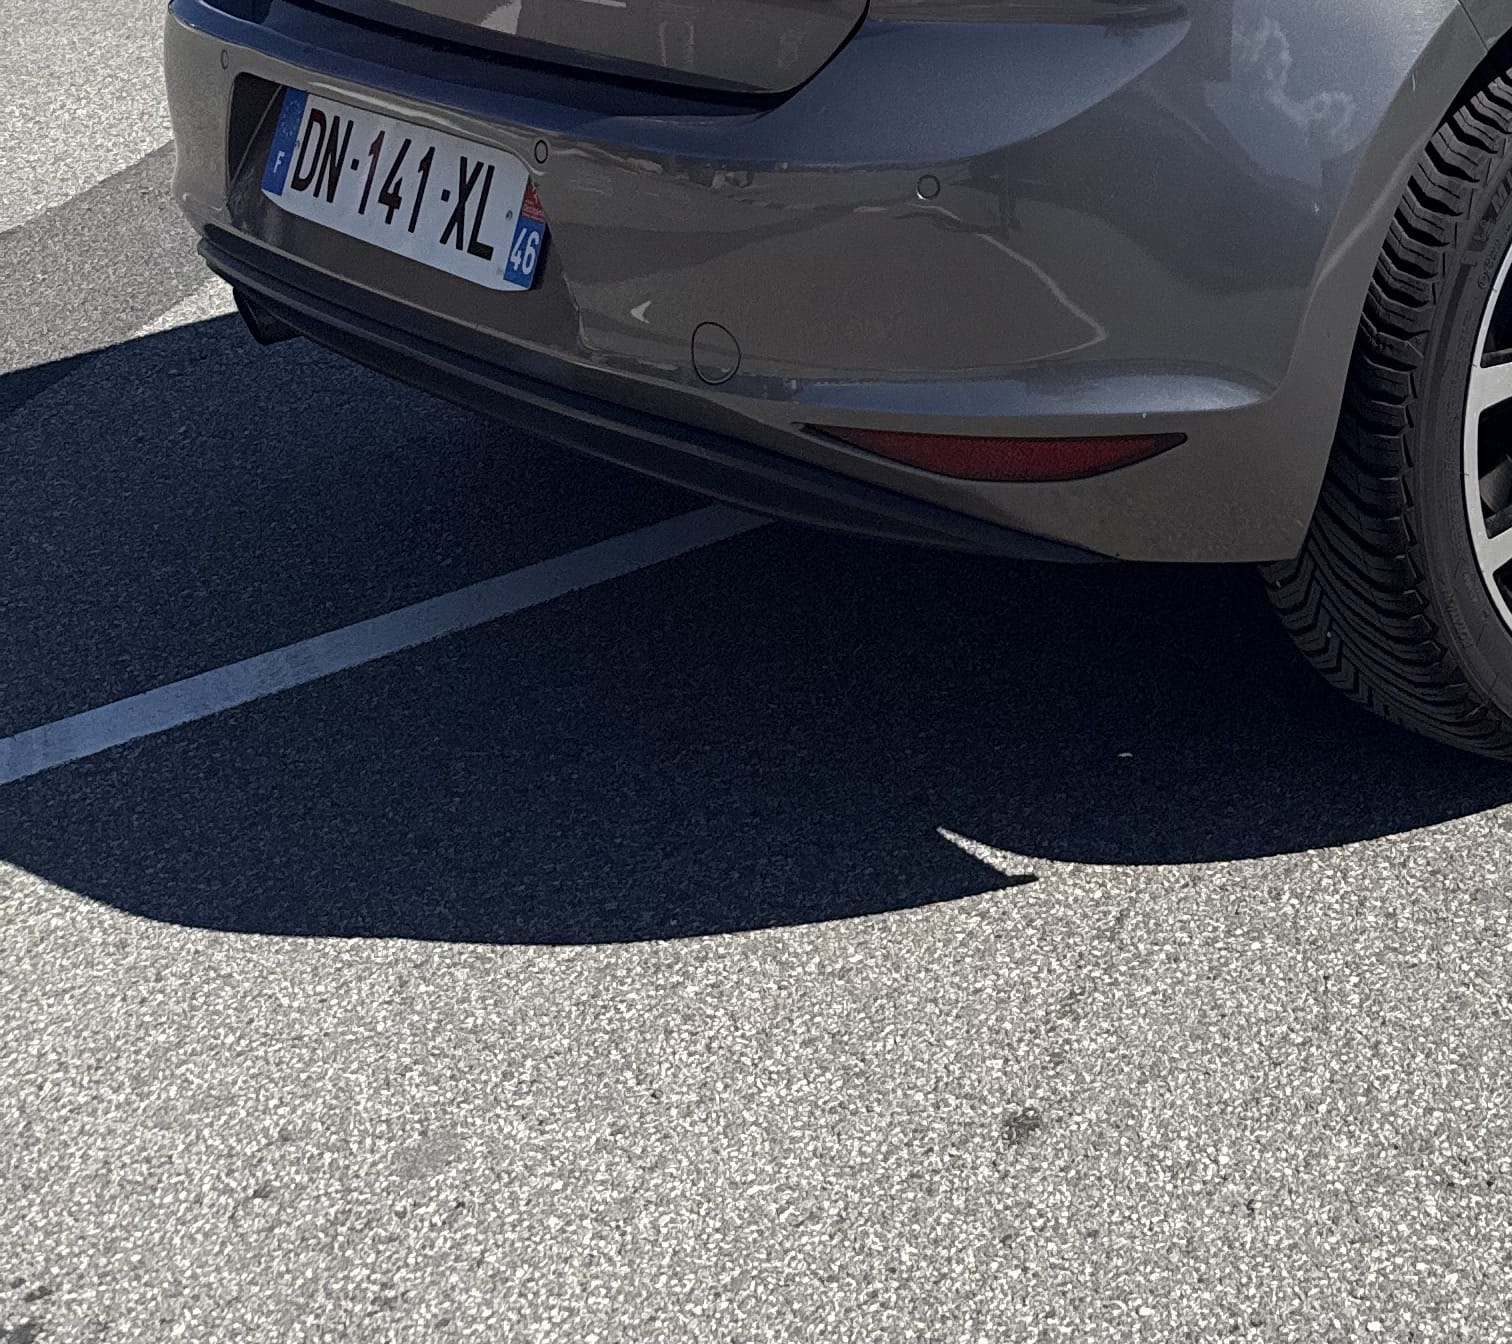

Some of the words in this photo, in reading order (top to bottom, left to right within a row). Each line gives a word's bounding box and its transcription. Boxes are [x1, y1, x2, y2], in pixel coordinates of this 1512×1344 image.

[273, 150, 286, 174] F
[290, 108, 495, 261] DN-141-XL
[510, 227, 540, 275] 46
